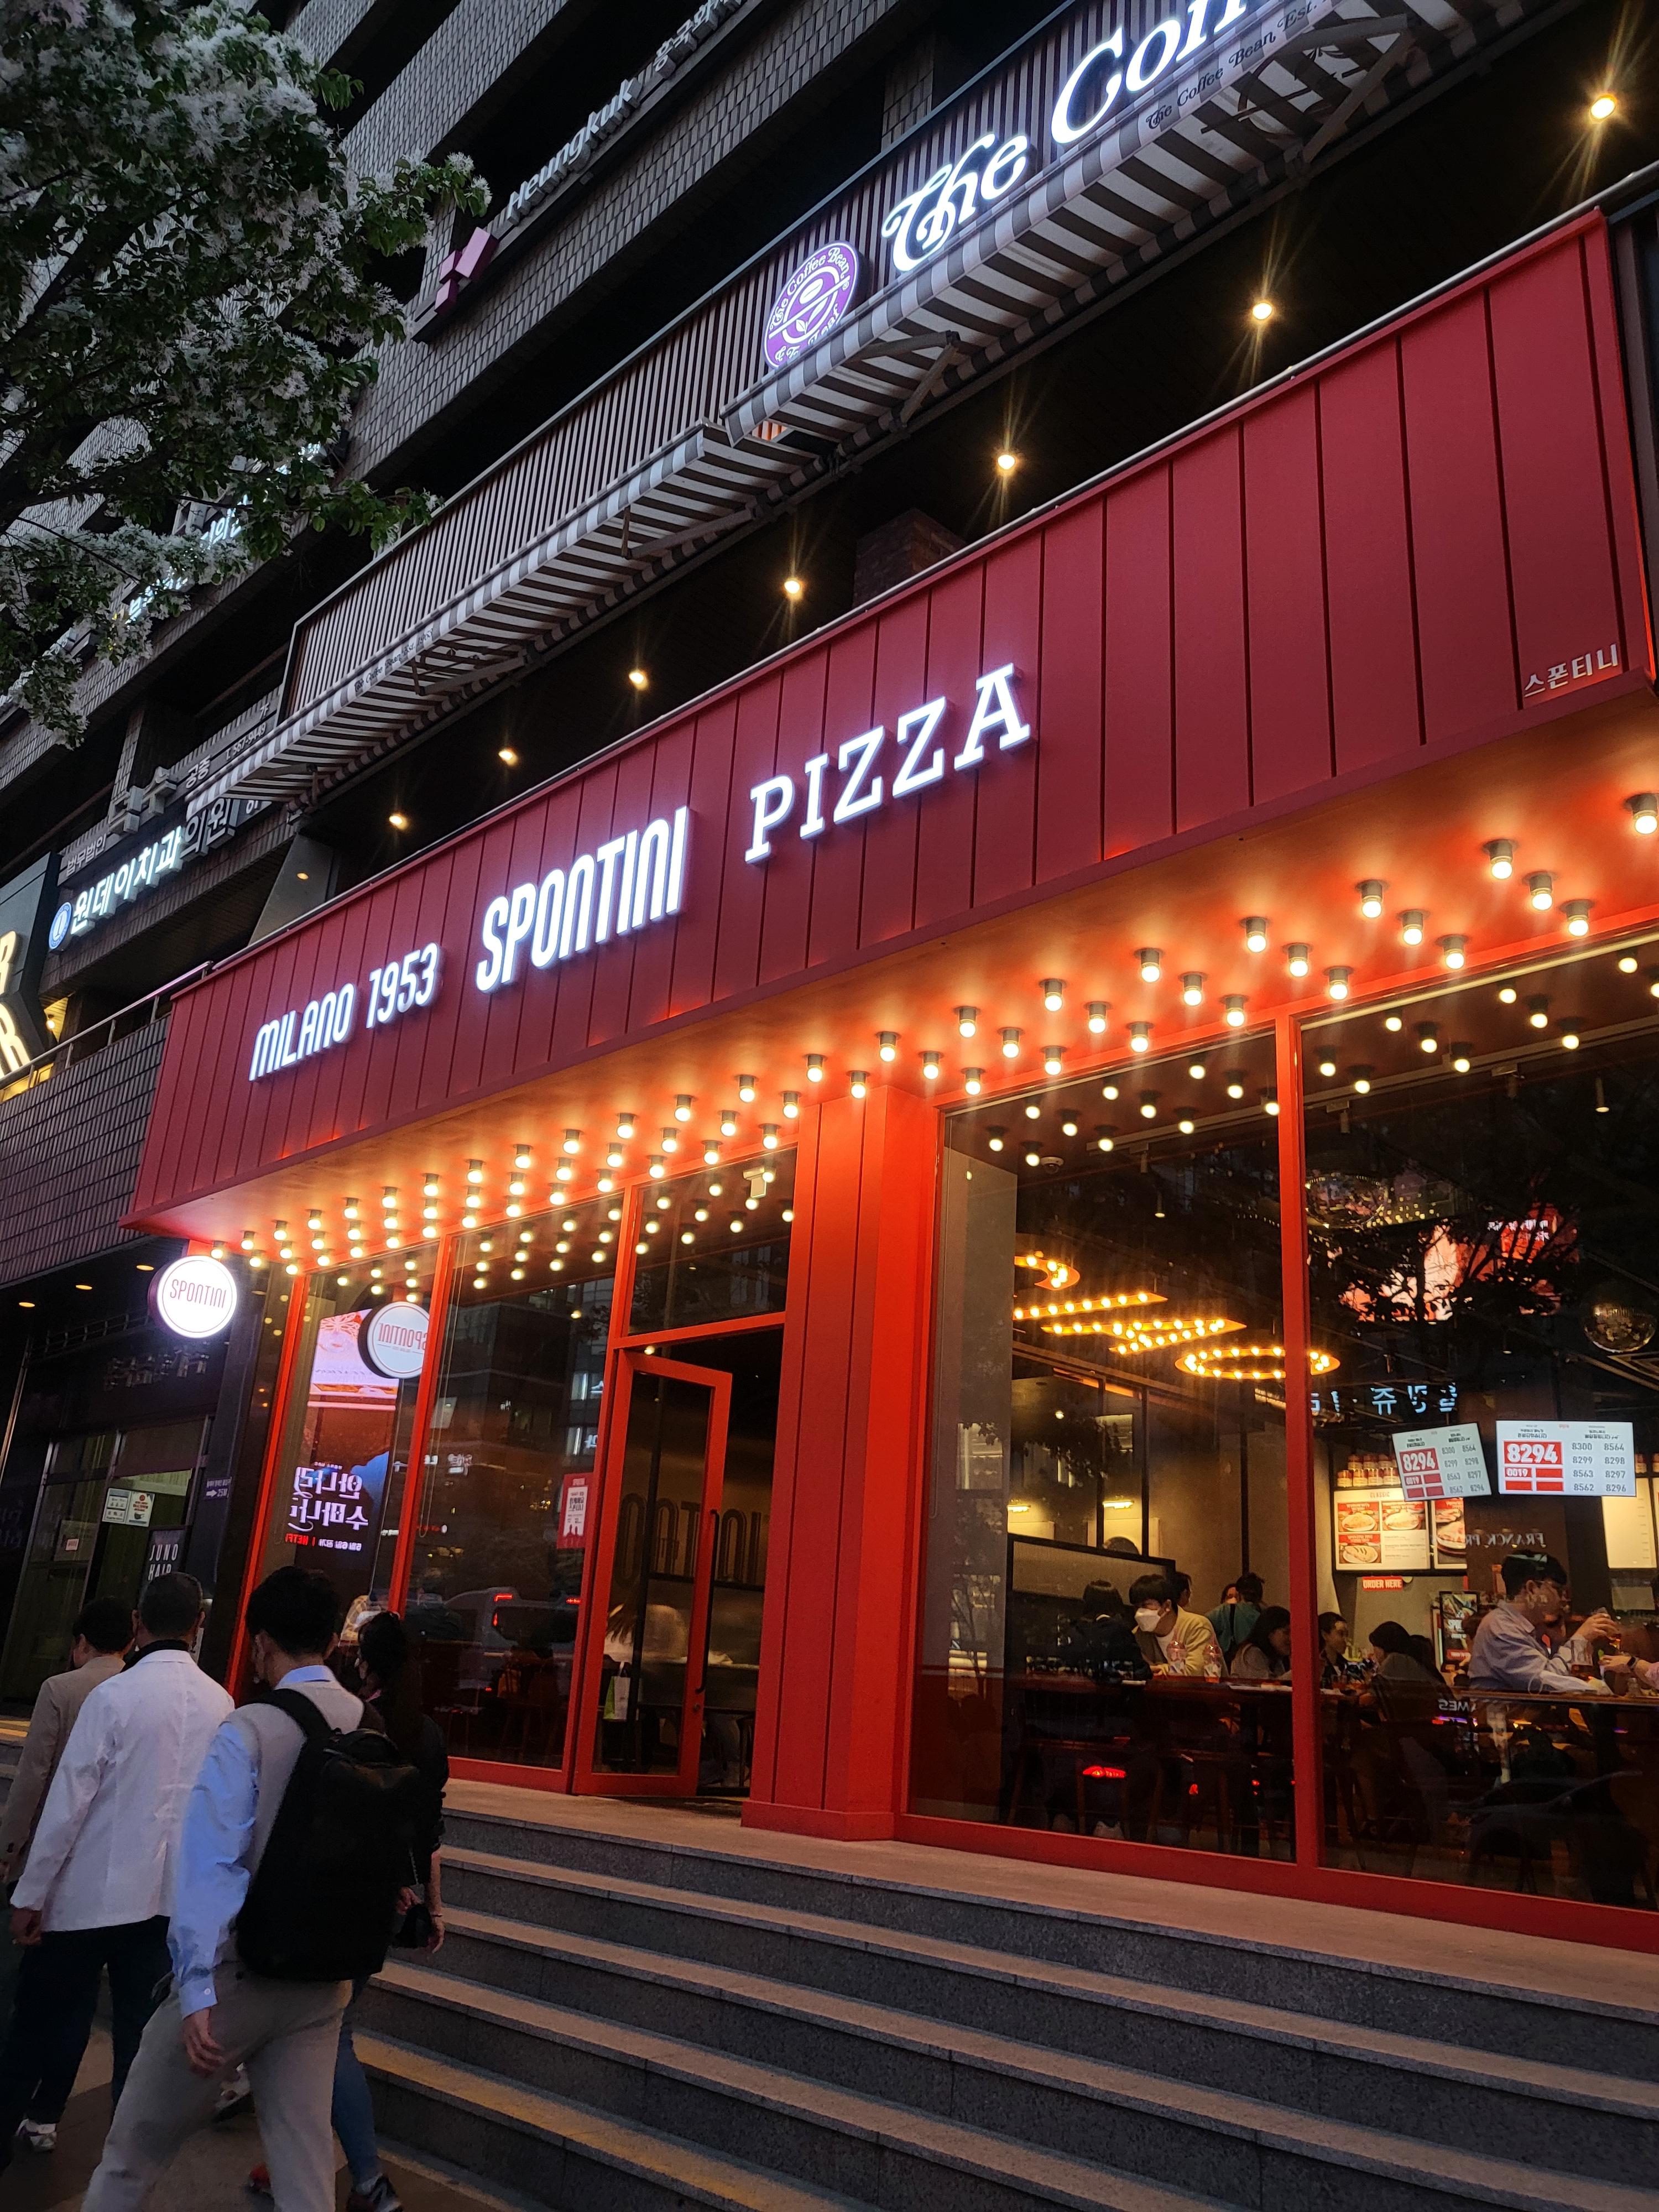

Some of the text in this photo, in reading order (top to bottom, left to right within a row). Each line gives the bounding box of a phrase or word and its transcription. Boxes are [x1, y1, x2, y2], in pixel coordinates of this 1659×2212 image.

[1146, 1, 1317, 129] The Coffee Bean Est.
[881, 133, 1029, 272] The
[769, 247, 850, 331] The Coffee Bean
[1524, 643, 1619, 697] 스폰티니
[66, 833, 107, 877] 법무법인
[248, 662, 1032, 1082] MILANO 1953 SPONTINI PIZZA
[169, 1277, 227, 1309] SPONTINI
[1507, 1443, 1558, 1464] 8294
[1573, 1456, 1593, 1464] 8299
[1604, 1443, 1624, 1451] 8564
[1403, 1451, 1435, 1472] 8294
[1506, 1468, 1528, 1477] 0019
[149, 1543, 179, 1562] JUNO
[1363, 1579, 1403, 1589] ORDER HERE
